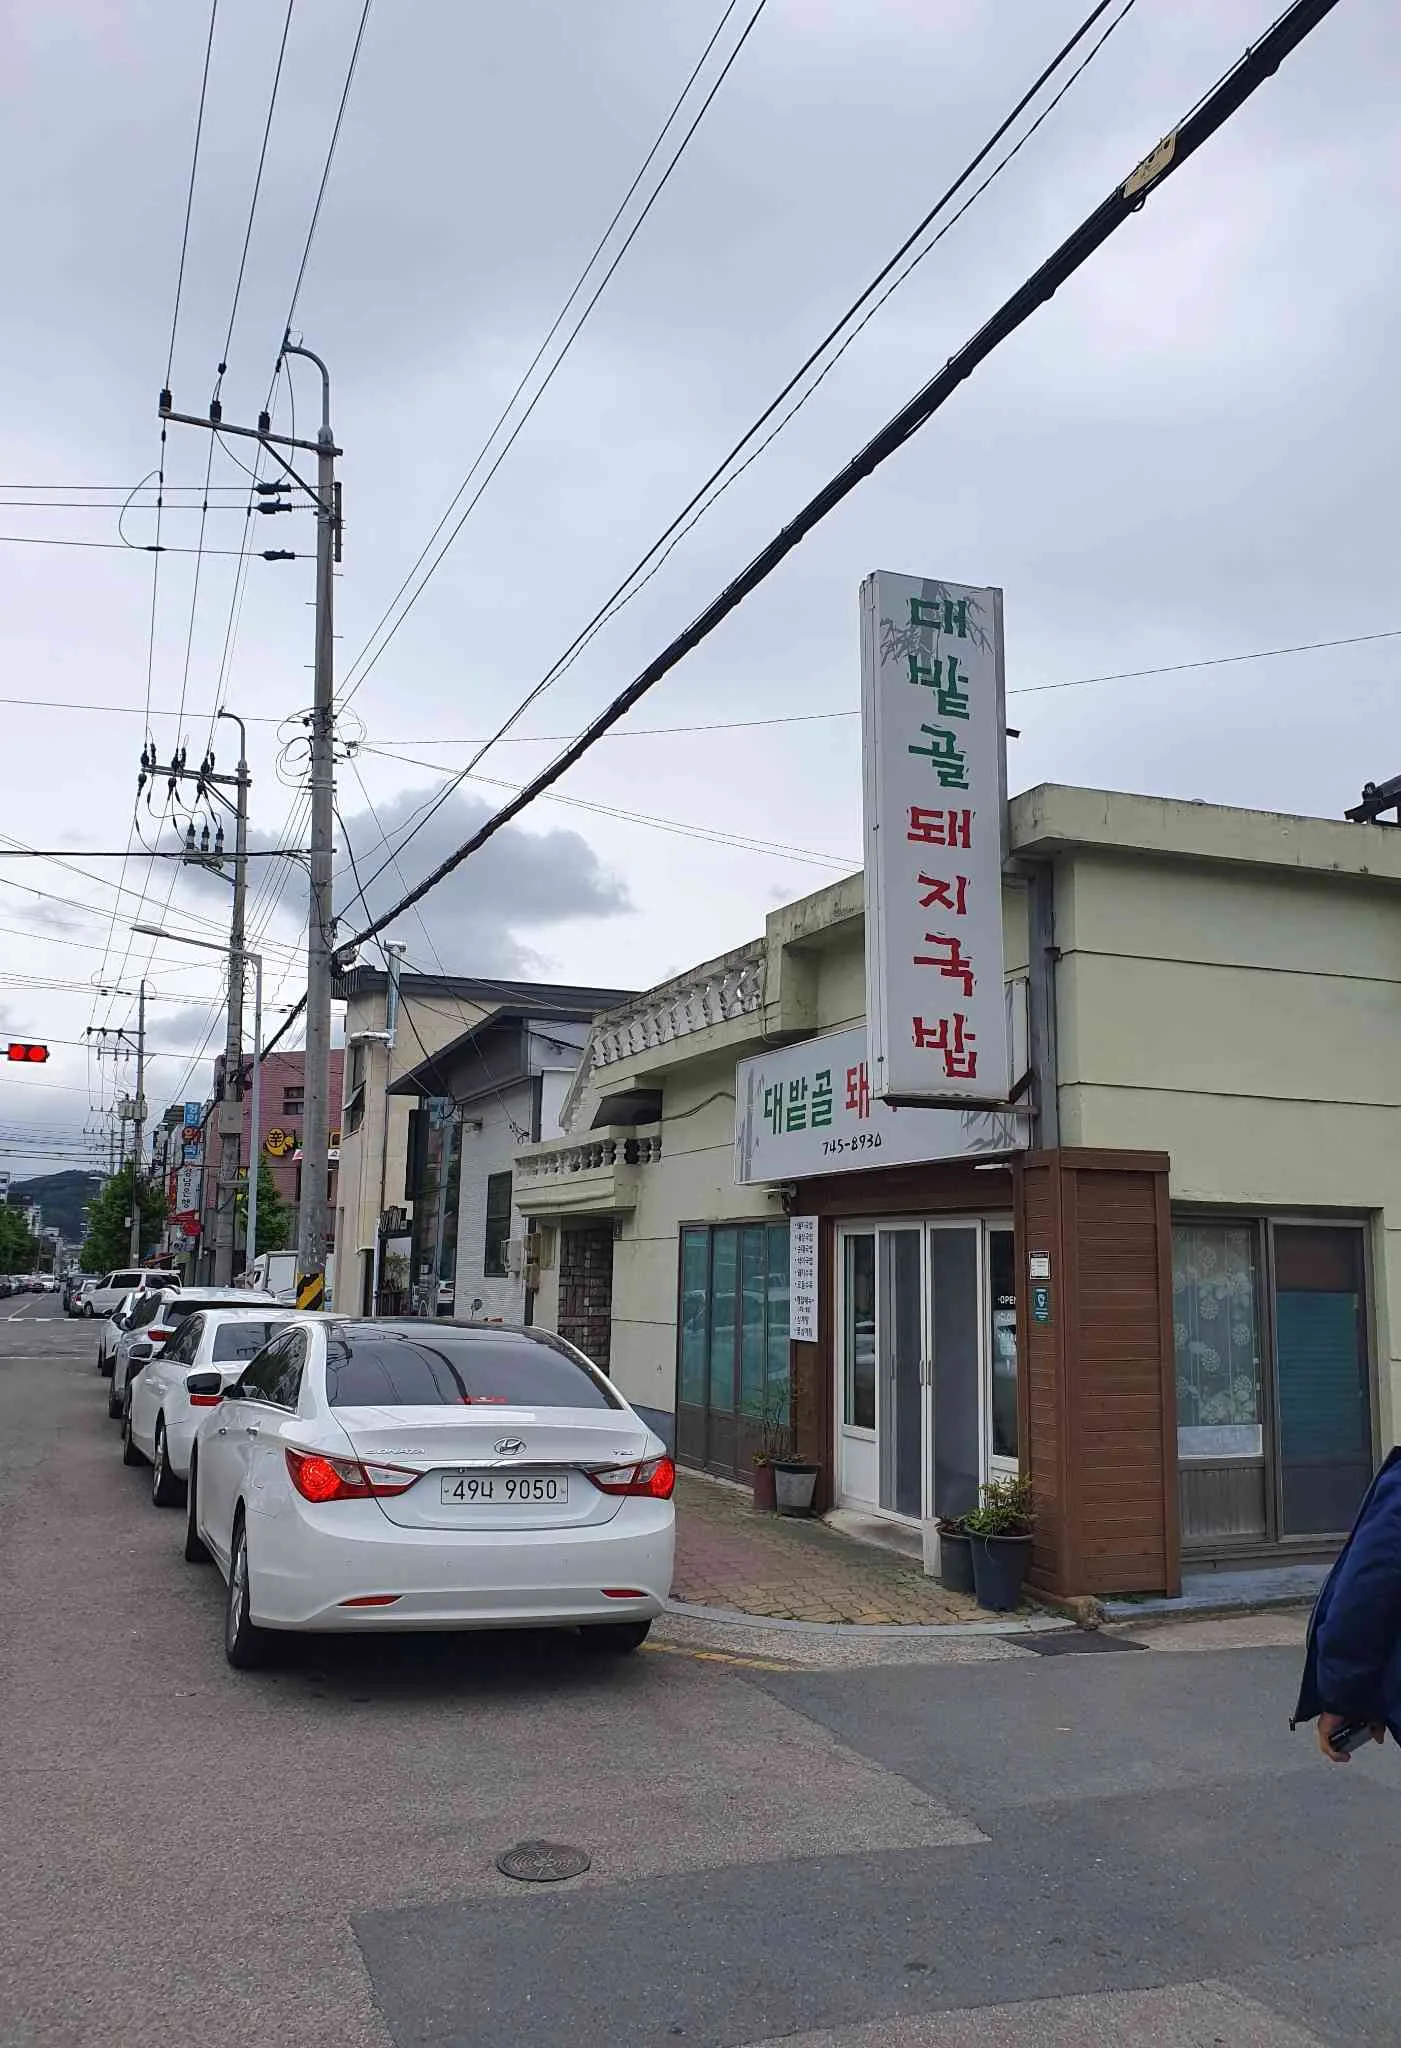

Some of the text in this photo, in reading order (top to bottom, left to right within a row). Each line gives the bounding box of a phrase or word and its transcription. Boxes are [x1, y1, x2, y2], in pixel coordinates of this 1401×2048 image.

[907, 596, 978, 1081] 대밭골 돼지국밥
[764, 1060, 870, 1135] 대밭골 돼
[822, 1132, 882, 1156] 745-8930
[452, 1479, 557, 1500] 49나 9050
